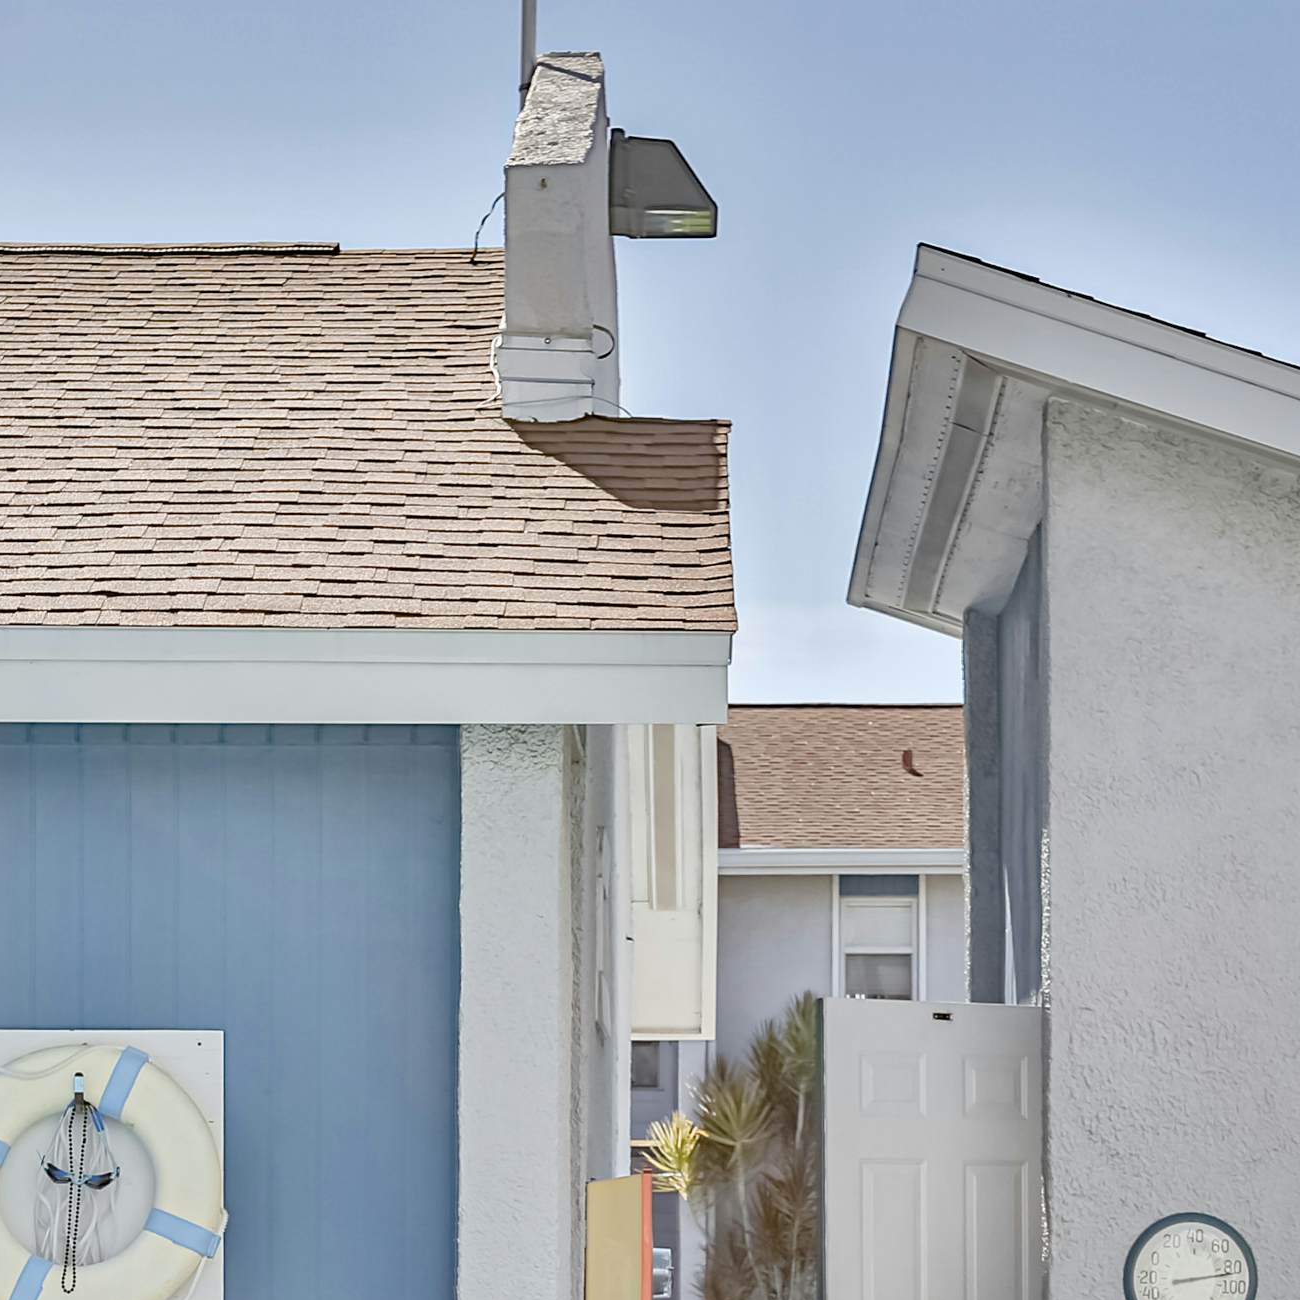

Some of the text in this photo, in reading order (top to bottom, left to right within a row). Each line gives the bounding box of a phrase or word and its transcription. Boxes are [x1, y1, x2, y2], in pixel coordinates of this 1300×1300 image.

[1163, 1234, 1181, 1249] 20
[1187, 1229, 1204, 1243] 40
[1211, 1239, 1230, 1253] 60
[1151, 1251, 1160, 1266] 0
[1224, 1260, 1242, 1274] 80
[1222, 1280, 1246, 1295] 100
